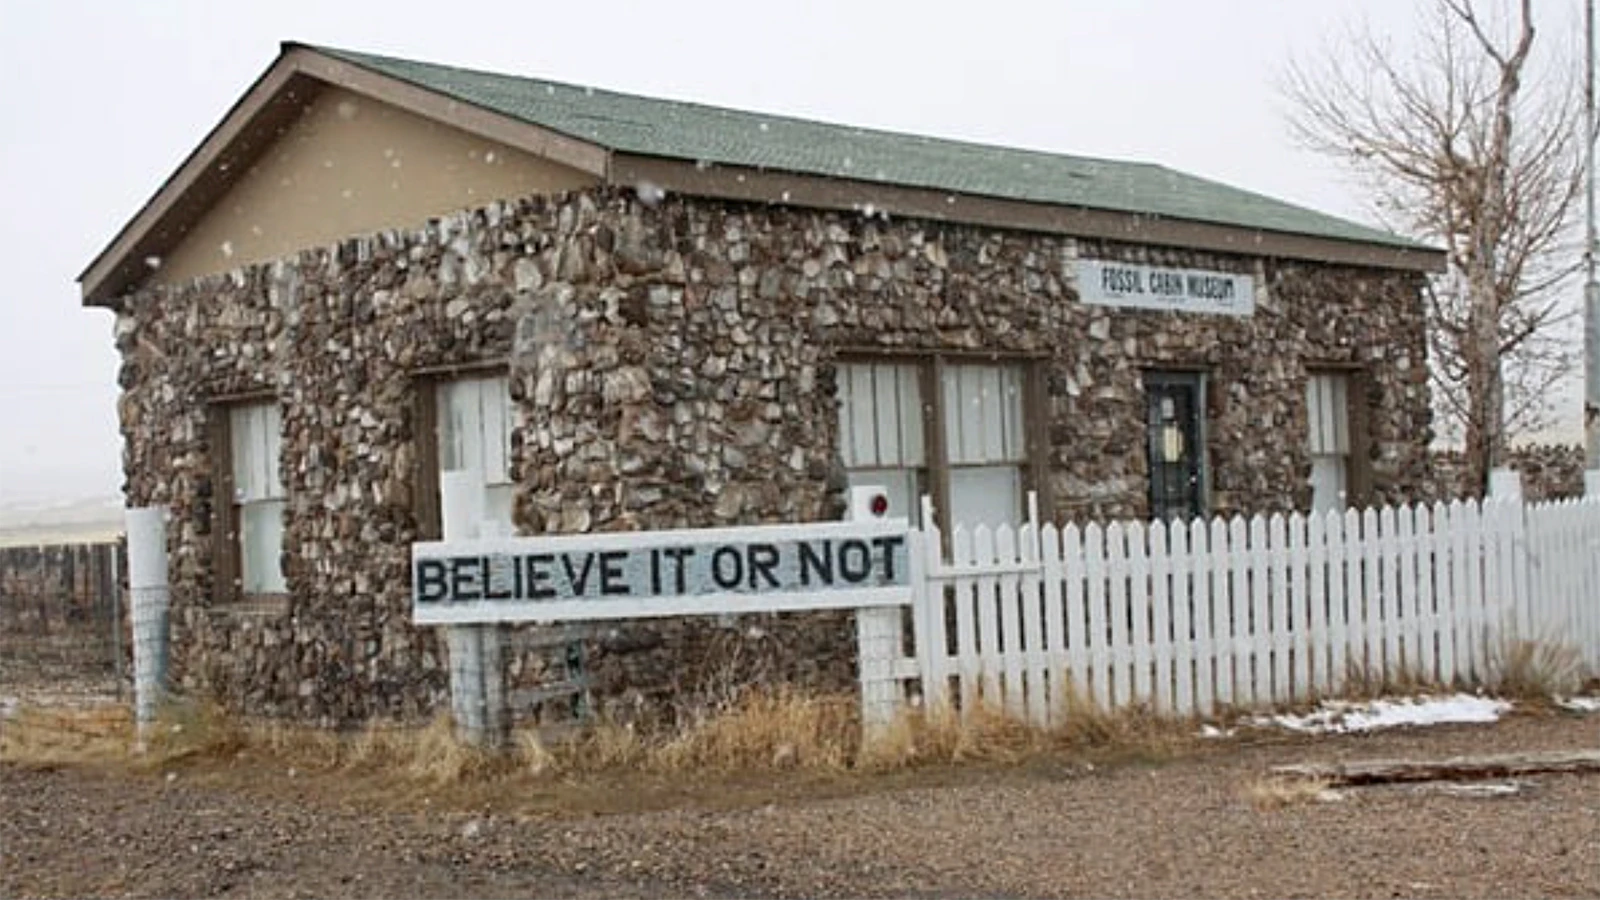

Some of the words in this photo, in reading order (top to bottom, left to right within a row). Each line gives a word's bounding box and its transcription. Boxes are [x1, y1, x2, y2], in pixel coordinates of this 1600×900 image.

[1101, 267, 1144, 294] FOSSIL
[1149, 271, 1183, 296] CABIN
[1186, 274, 1236, 300] MUSEUM
[416, 551, 631, 602] BELIEVE
[651, 547, 695, 595] IT
[711, 543, 781, 589] OR
[797, 535, 904, 586] NOT
